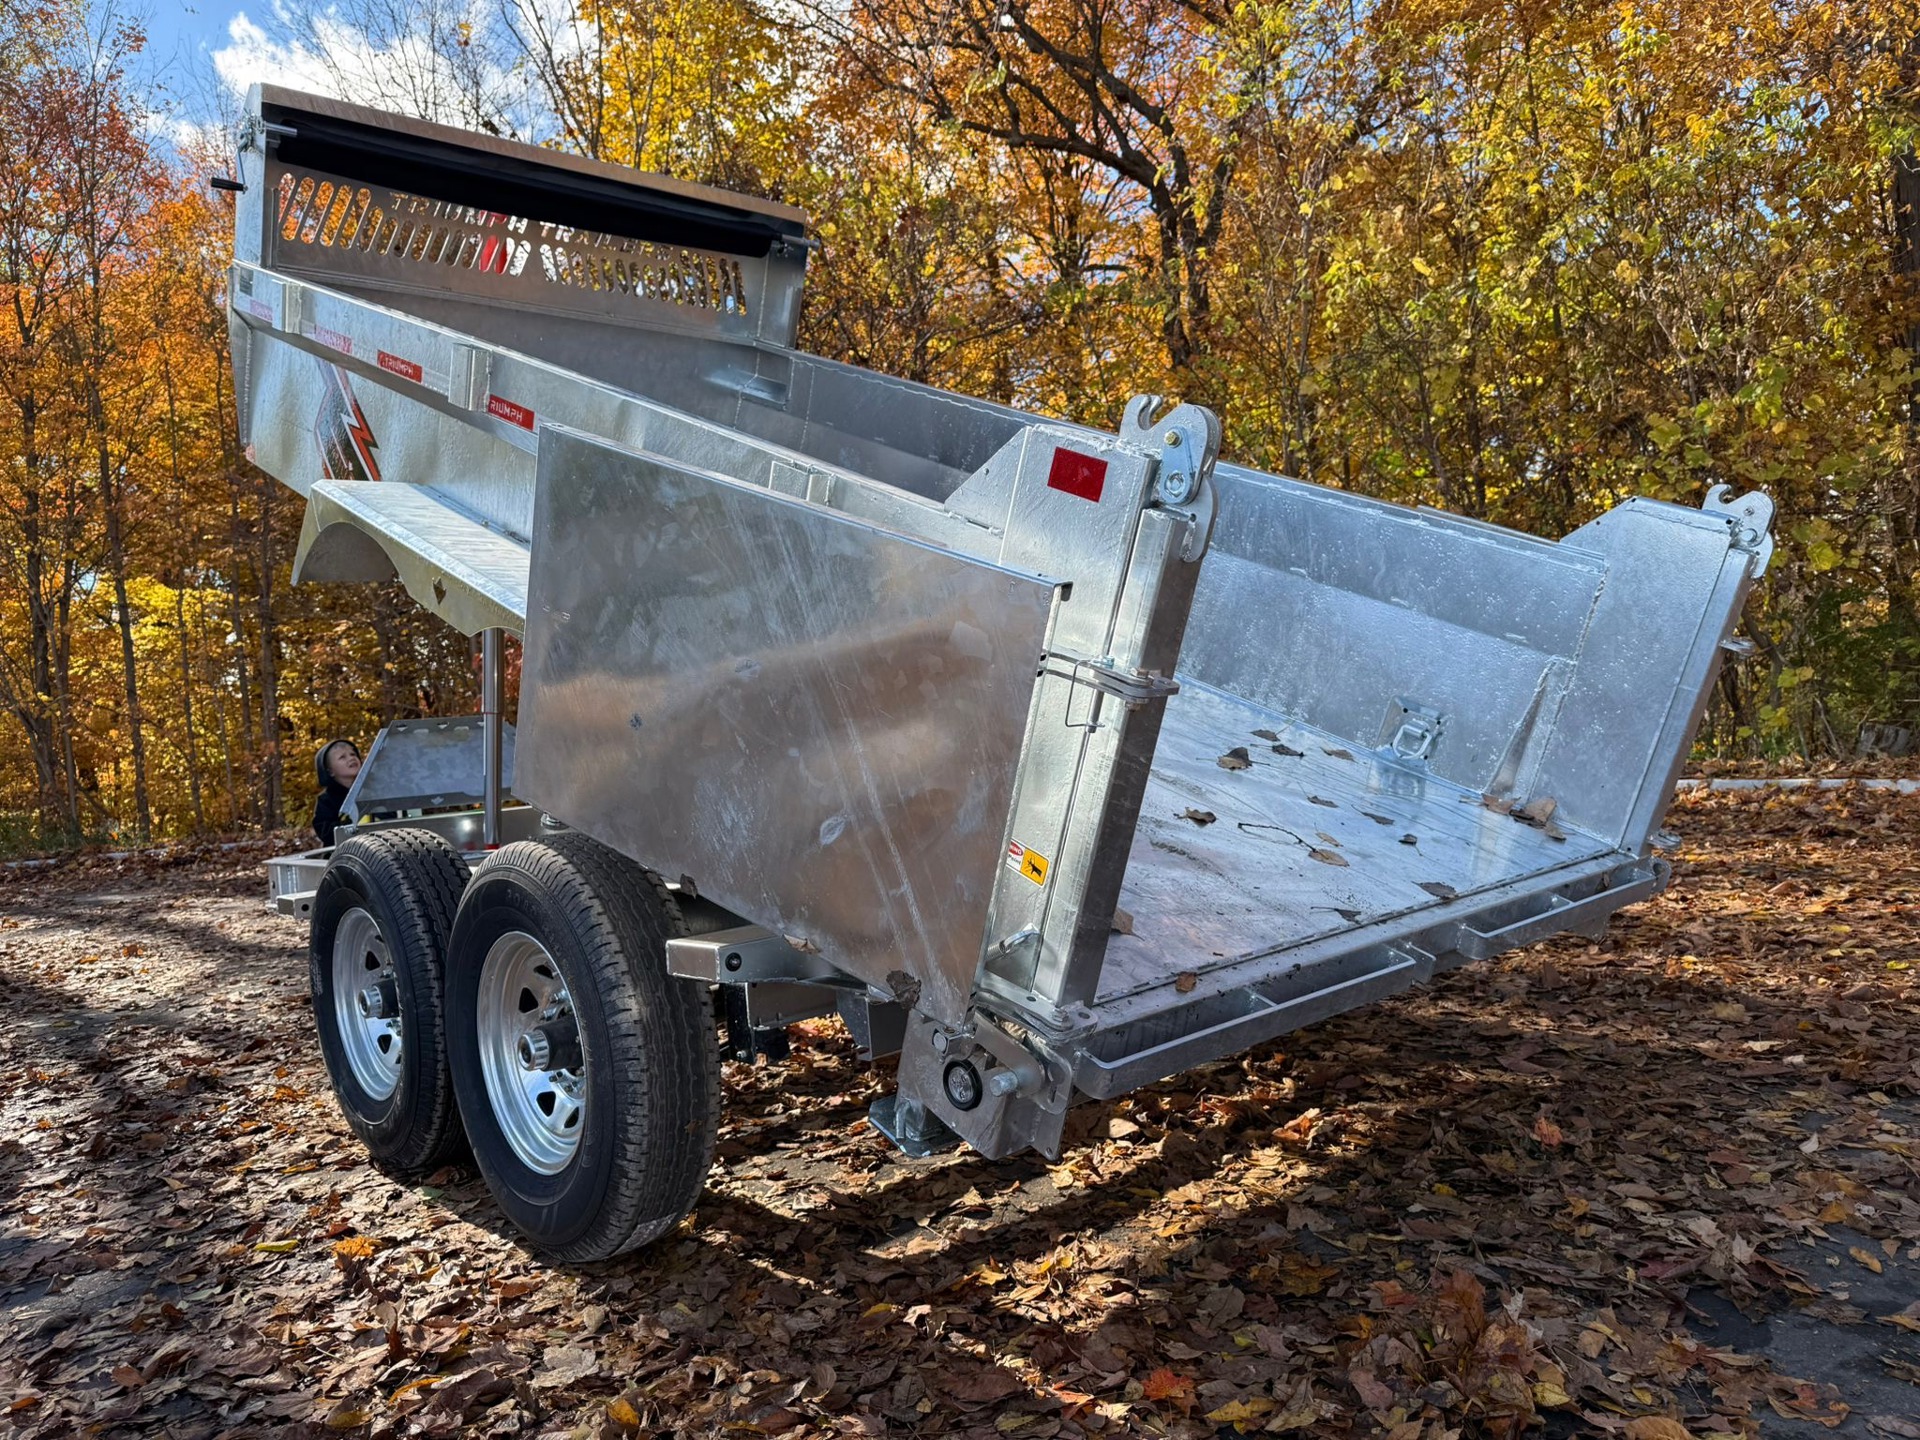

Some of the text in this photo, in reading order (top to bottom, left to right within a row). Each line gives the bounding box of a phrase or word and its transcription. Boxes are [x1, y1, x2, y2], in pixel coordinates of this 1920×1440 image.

[389, 191, 674, 261] TRIUMPH TRAILERS
[490, 400, 523, 422] RIUMPH
